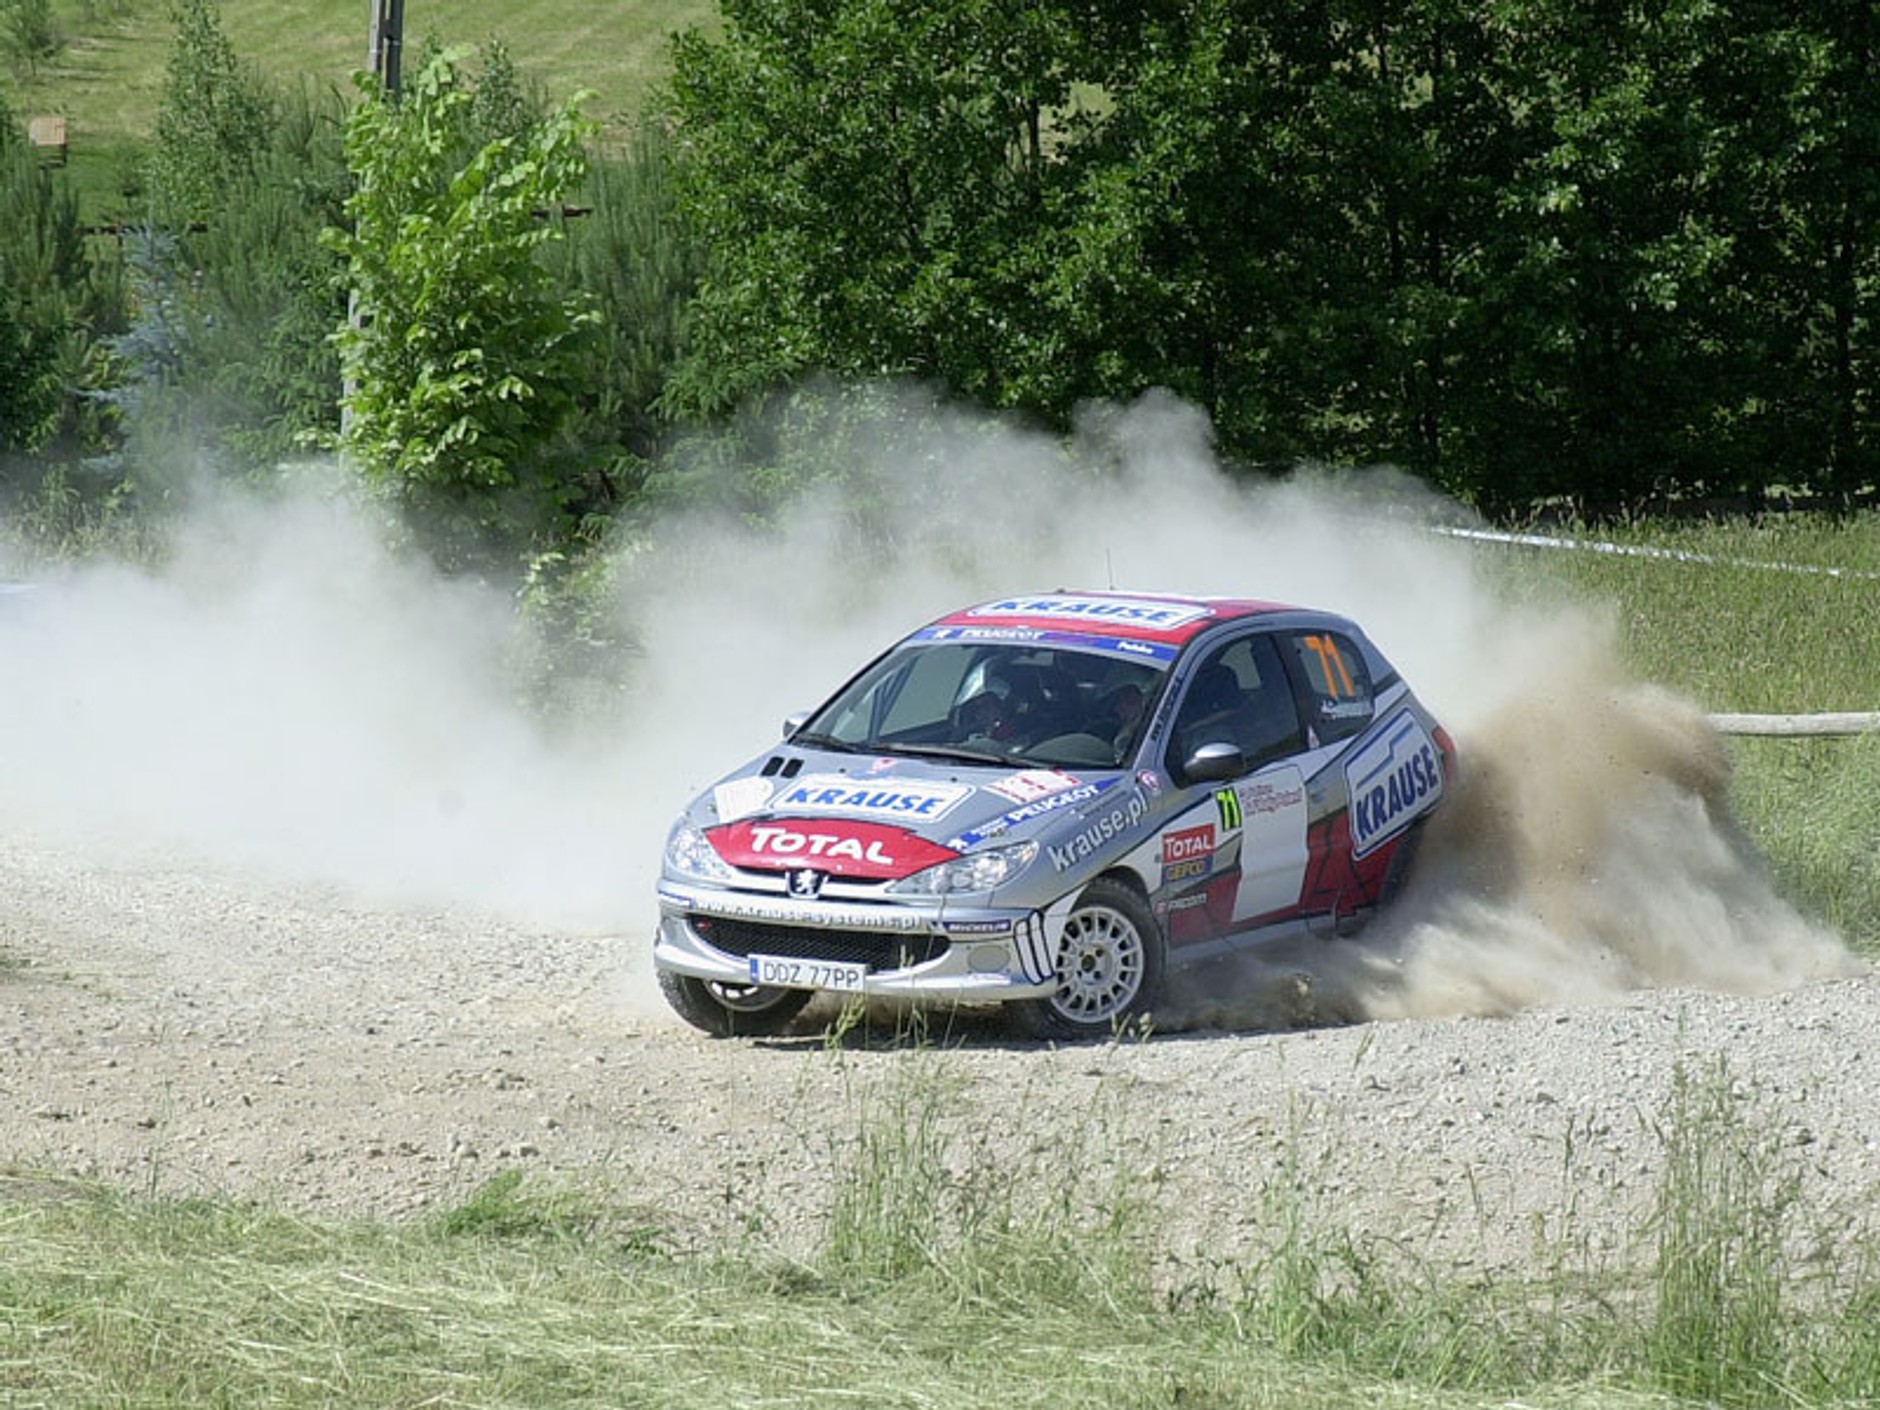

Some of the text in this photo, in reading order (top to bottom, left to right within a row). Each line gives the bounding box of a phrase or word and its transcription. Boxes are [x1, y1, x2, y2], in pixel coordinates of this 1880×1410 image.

[994, 601, 1176, 621] KRAUSE
[959, 629, 1044, 641] PEUGEOT
[1303, 633, 1355, 698] 71
[784, 787, 944, 815] KRAUSE
[1008, 784, 1100, 822] PEUGEOT
[1217, 788, 1241, 831] 71
[1356, 745, 1438, 840] KRAUSE
[751, 827, 893, 865] TOTAL
[1048, 786, 1149, 872] krause.pl
[1164, 834, 1212, 859] TOTAL
[763, 963, 859, 989] DDZ 77PP
